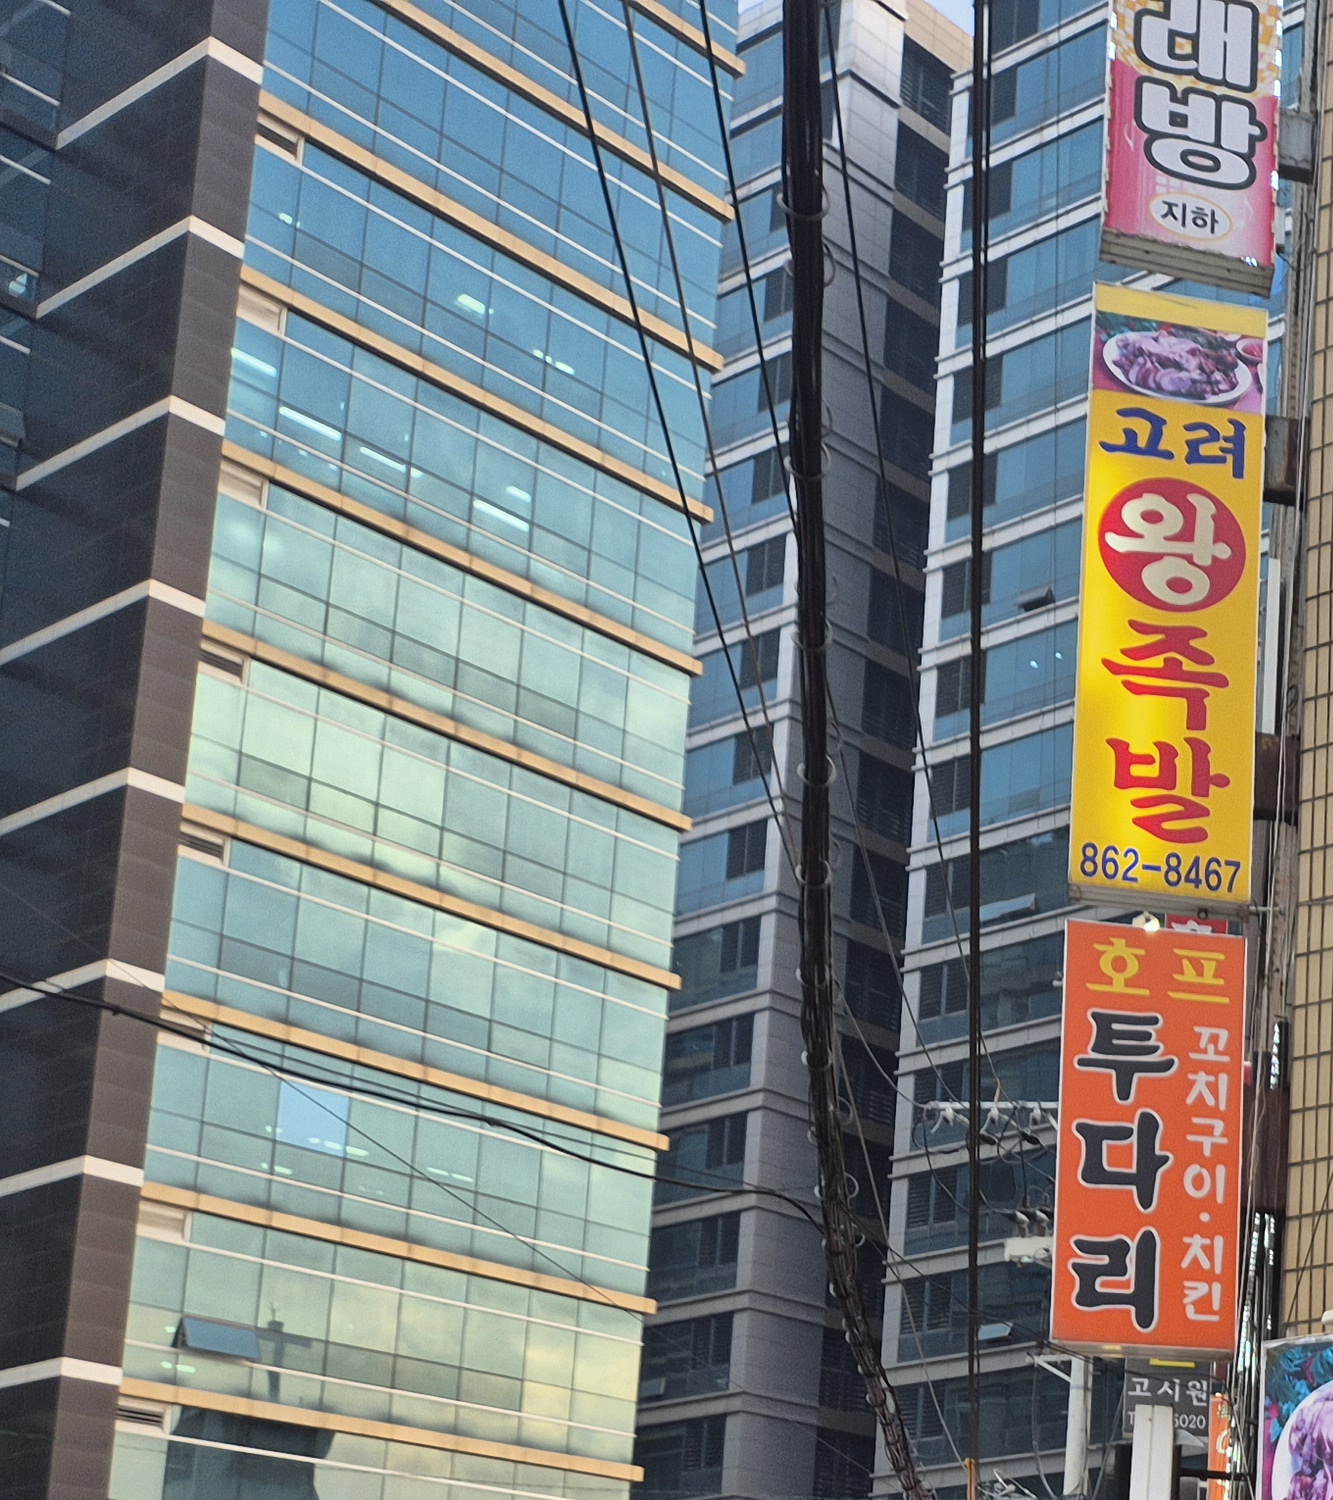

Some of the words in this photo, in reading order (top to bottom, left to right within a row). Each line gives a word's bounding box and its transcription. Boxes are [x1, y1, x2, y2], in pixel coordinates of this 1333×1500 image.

[1160, 200, 1219, 236] 지하
[1099, 406, 1246, 480] 고려
[1101, 618, 1231, 843] 족발
[1079, 841, 1242, 894] 862-8467
[1086, 936, 1231, 1003] 호프
[1067, 1008, 1179, 1334] 투다리
[1127, 1377, 1209, 1407] 고시원
